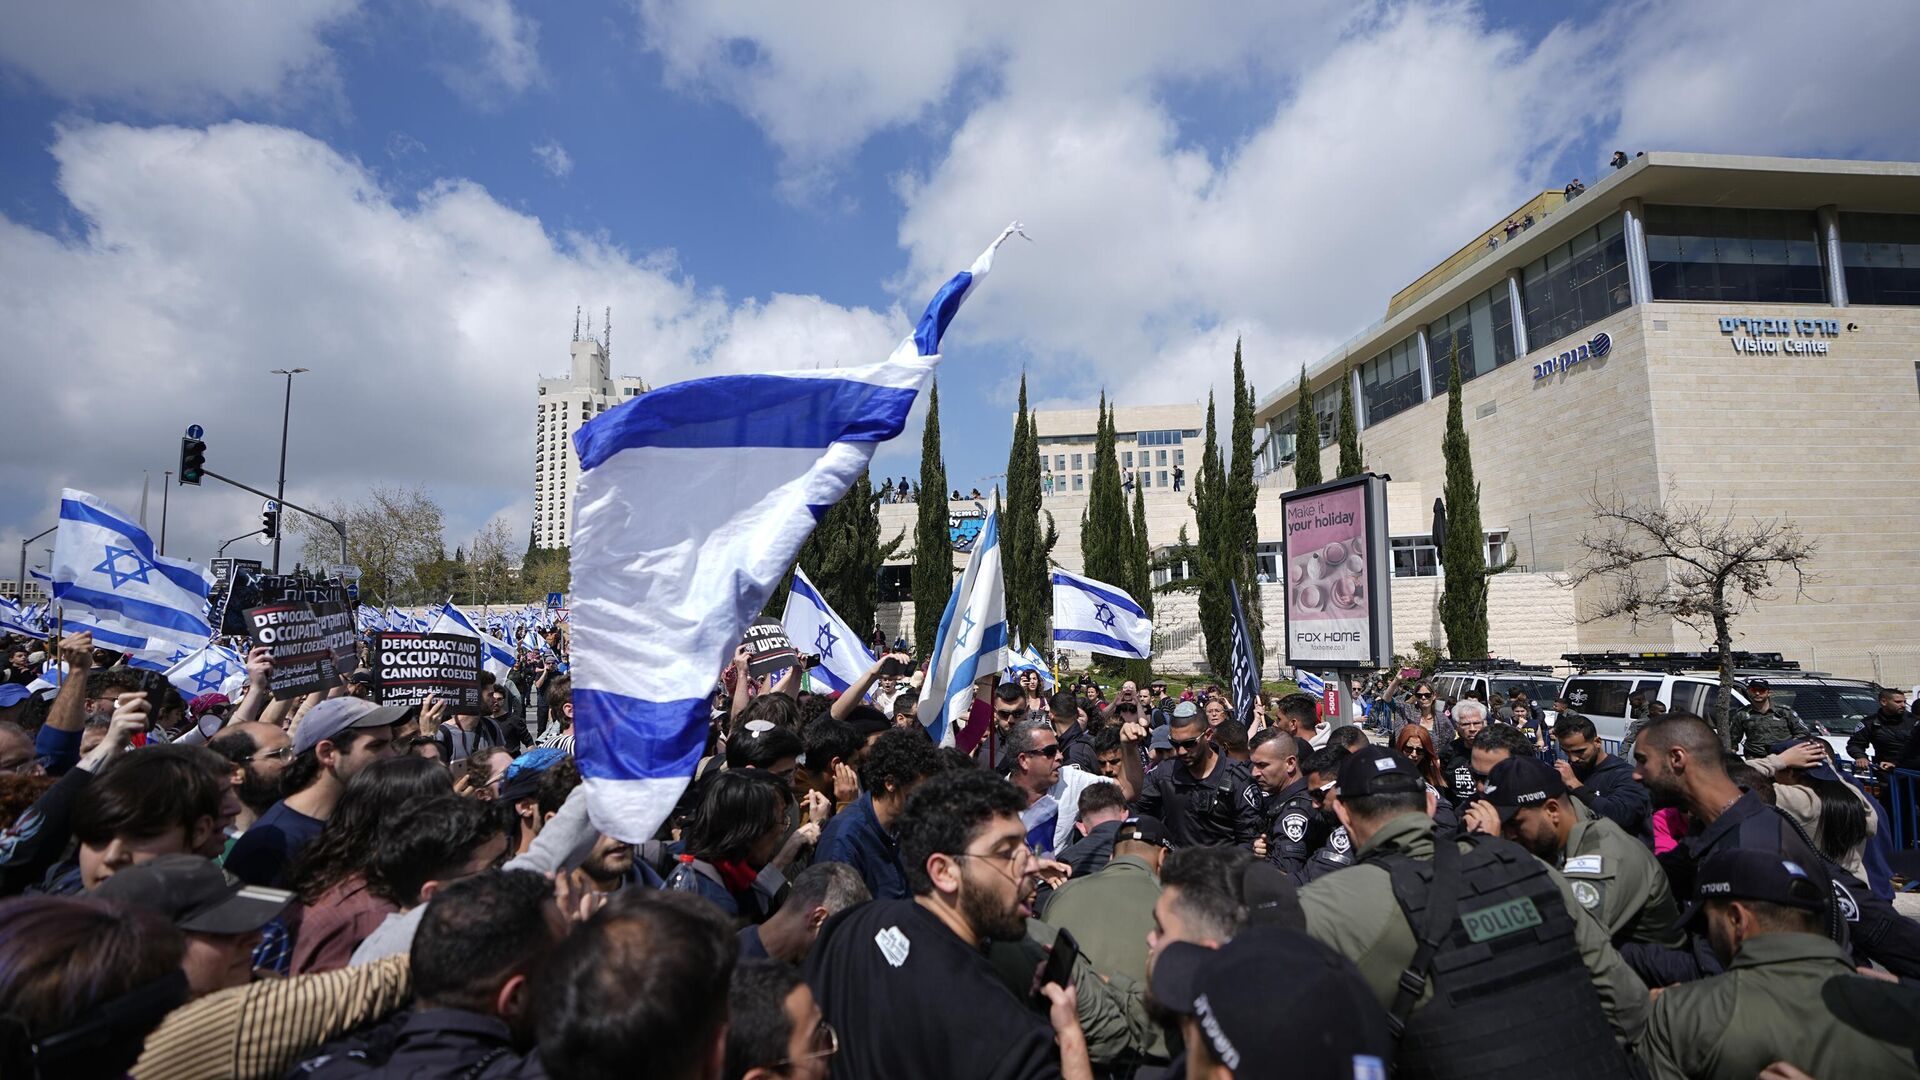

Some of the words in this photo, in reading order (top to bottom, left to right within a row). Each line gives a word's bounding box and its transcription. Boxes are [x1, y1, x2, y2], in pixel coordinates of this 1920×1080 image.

[1719, 317, 1792, 336] מבקרים
[1794, 319, 1839, 334] מרכז
[1732, 336, 1780, 352] Visitor
[1783, 339, 1831, 353] Center
[1533, 356, 1558, 380] יהב
[1288, 506, 1315, 519] Make
[1318, 501, 1325, 514] it
[1288, 520, 1312, 536] your
[1315, 512, 1354, 528] holiday
[1297, 632, 1321, 642] FOX
[1324, 631, 1361, 642] HOME
[381, 639, 457, 650] DEMOCRACY
[458, 642, 476, 653] AND
[381, 651, 477, 668] OCCUPATION
[381, 667, 439, 679] CANNOT
[441, 668, 477, 680] COEXIST
[1517, 790, 1547, 803] משטרה
[1701, 882, 1731, 894] משטרה
[1466, 901, 1538, 938] POLICE
